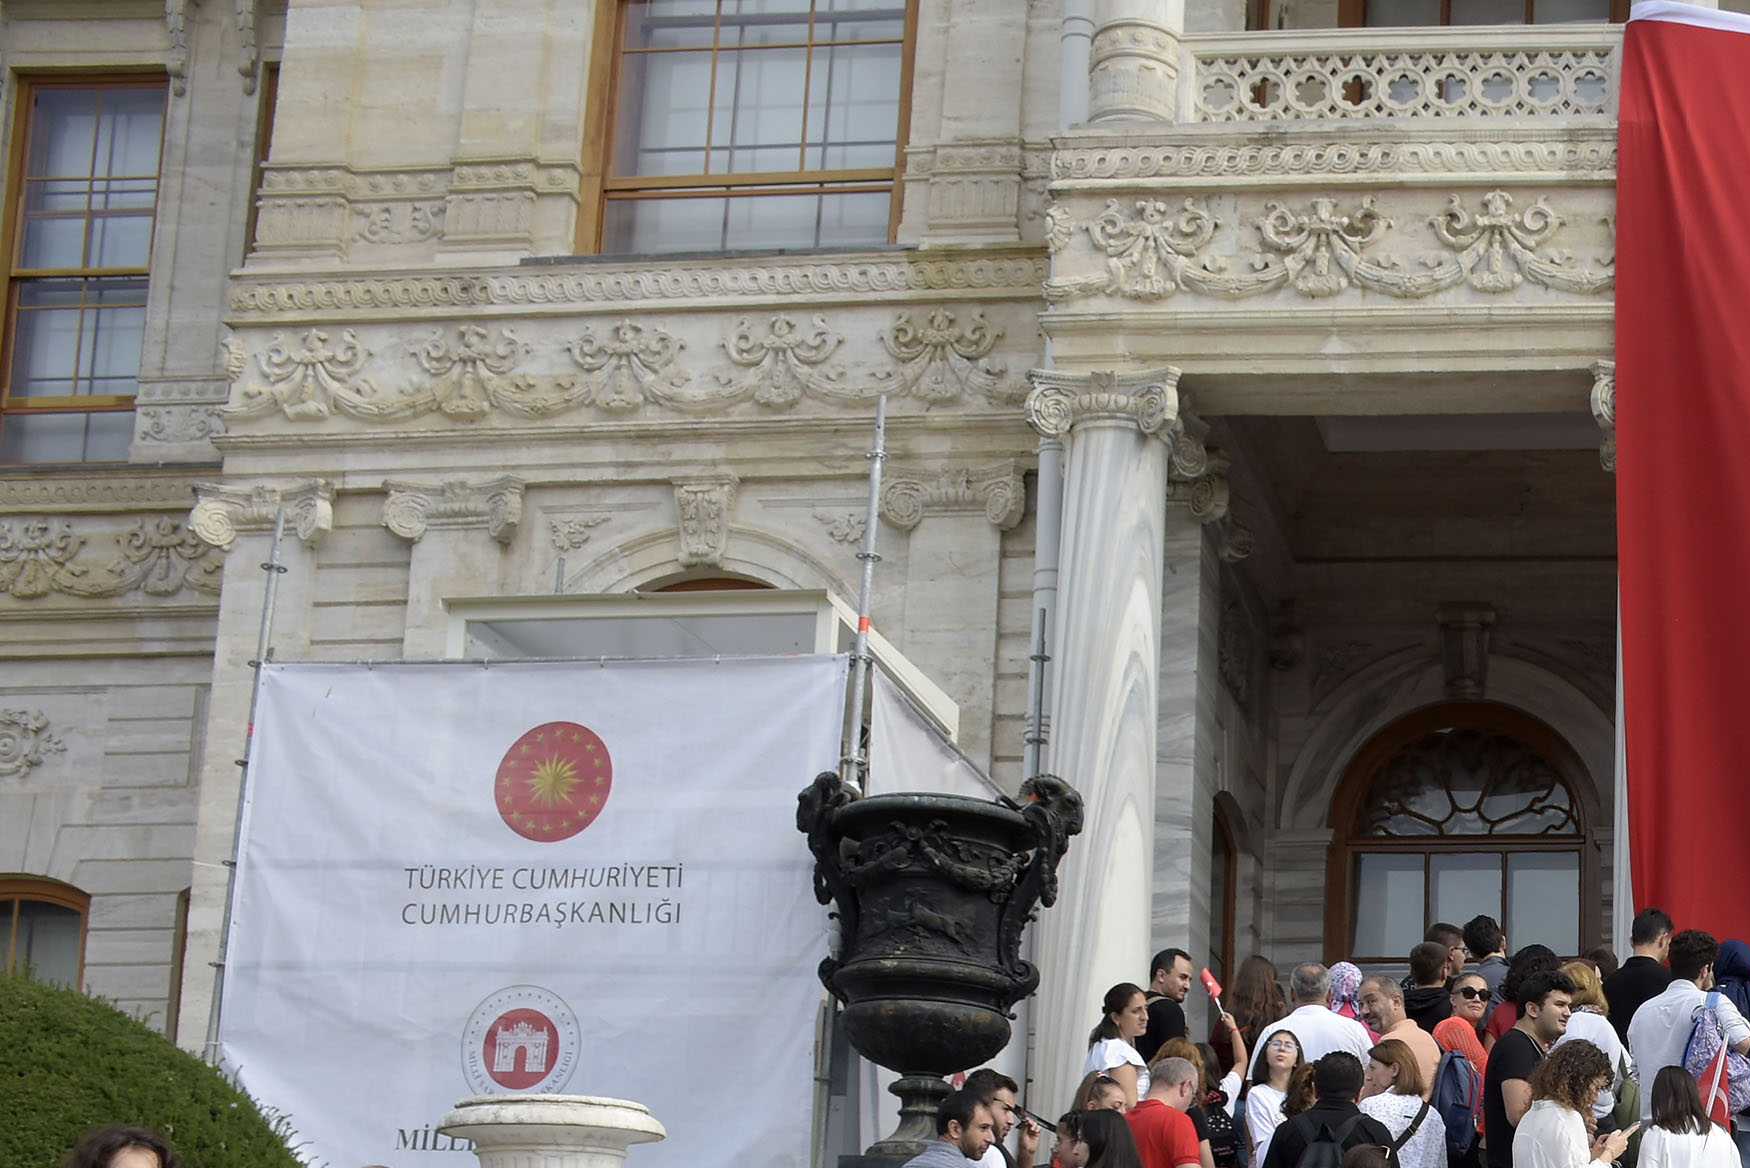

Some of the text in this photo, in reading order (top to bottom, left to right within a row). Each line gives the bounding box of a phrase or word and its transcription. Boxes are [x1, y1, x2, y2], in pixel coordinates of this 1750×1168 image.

[403, 862, 684, 890] TÜRKİYE CUMHURİYETİ
[401, 898, 682, 929] CUMHURBAŞKANLIĞI
